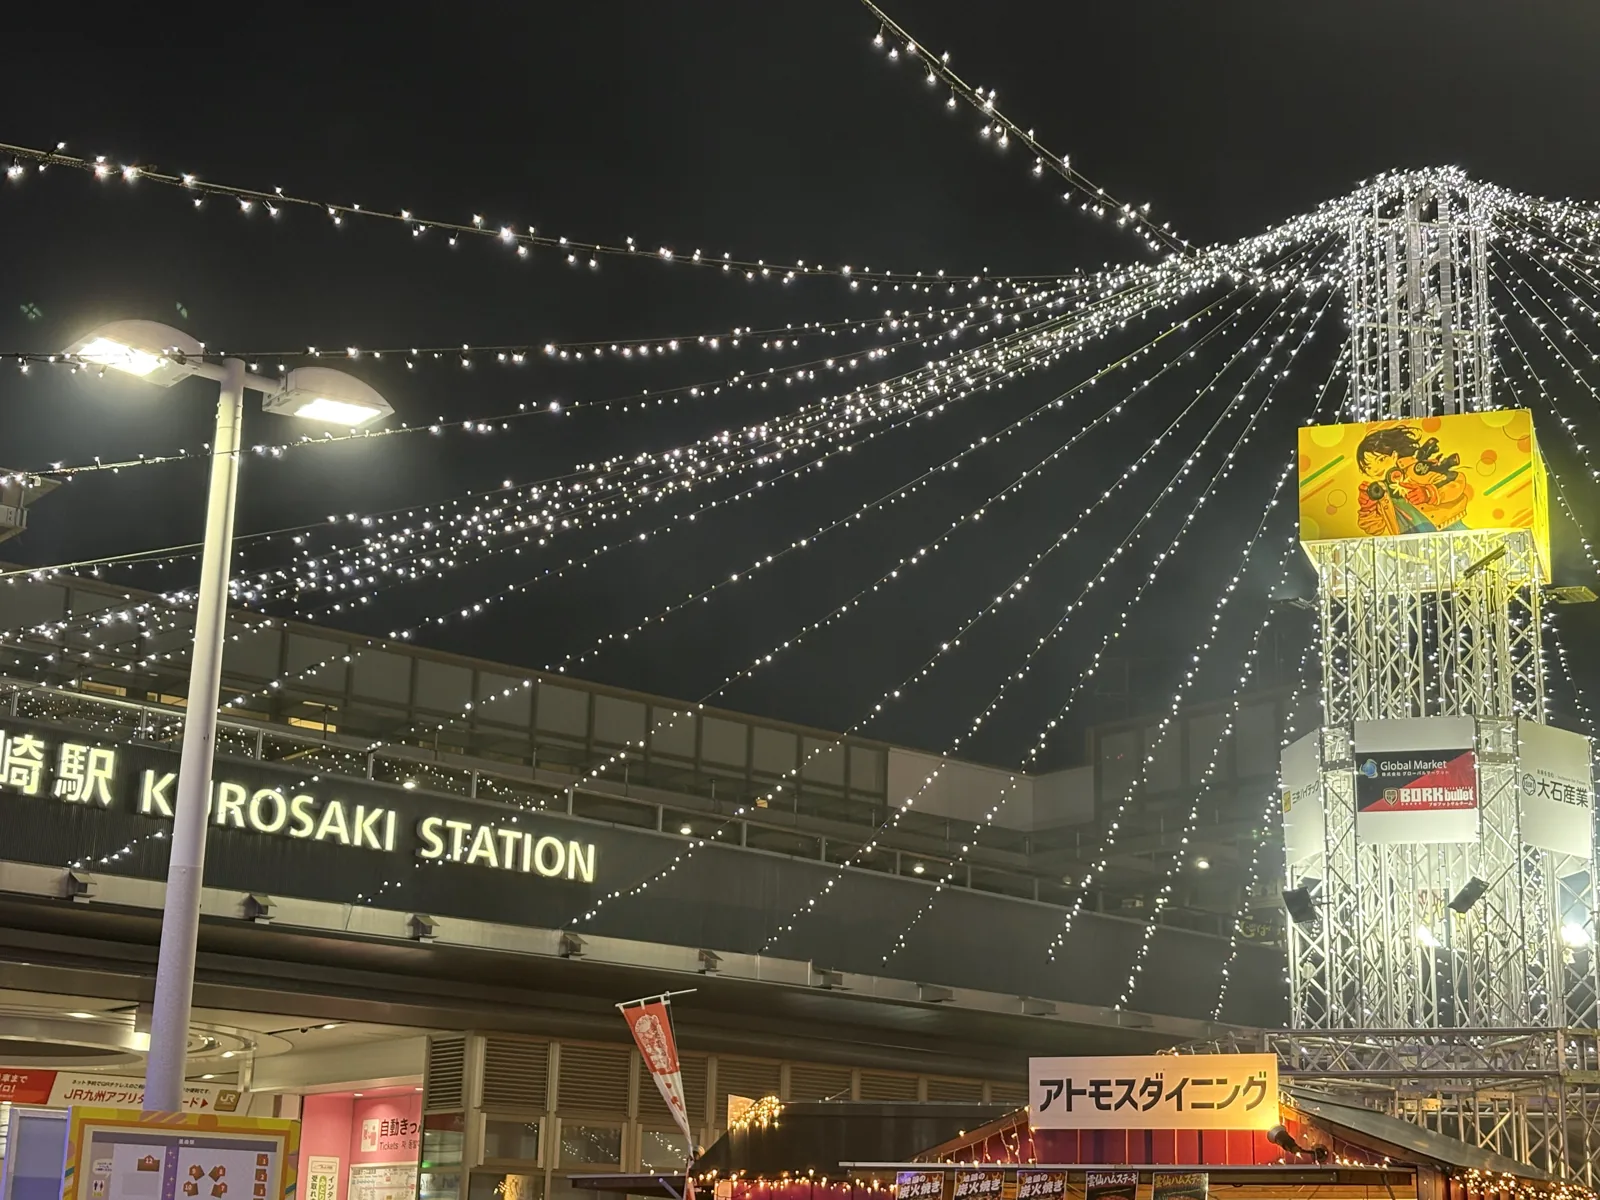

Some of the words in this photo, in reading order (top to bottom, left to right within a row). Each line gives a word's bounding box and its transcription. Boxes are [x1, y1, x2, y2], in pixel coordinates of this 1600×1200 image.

[1380, 760, 1411, 771] Global
[1413, 759, 1448, 770] Market
[1399, 787, 1443, 803] BORK
[1444, 787, 1474, 802] bullet
[1537, 778, 1589, 808] 大石産業
[0, 730, 115, 807] 崎駅
[140, 769, 396, 851] KROSAKI
[418, 816, 596, 882] STATION
[1039, 1071, 1268, 1112] アトモスダイニング
[310, 1174, 318, 1200] 受取れ
[327, 1175, 335, 1200] インタ
[956, 1179, 1001, 1196] 炭火焼き
[1087, 1172, 1137, 1187] 雲仙ハムステーキ
[899, 1181, 940, 1199] 炭火焼き
[1019, 1180, 1064, 1198] 炭火焼き
